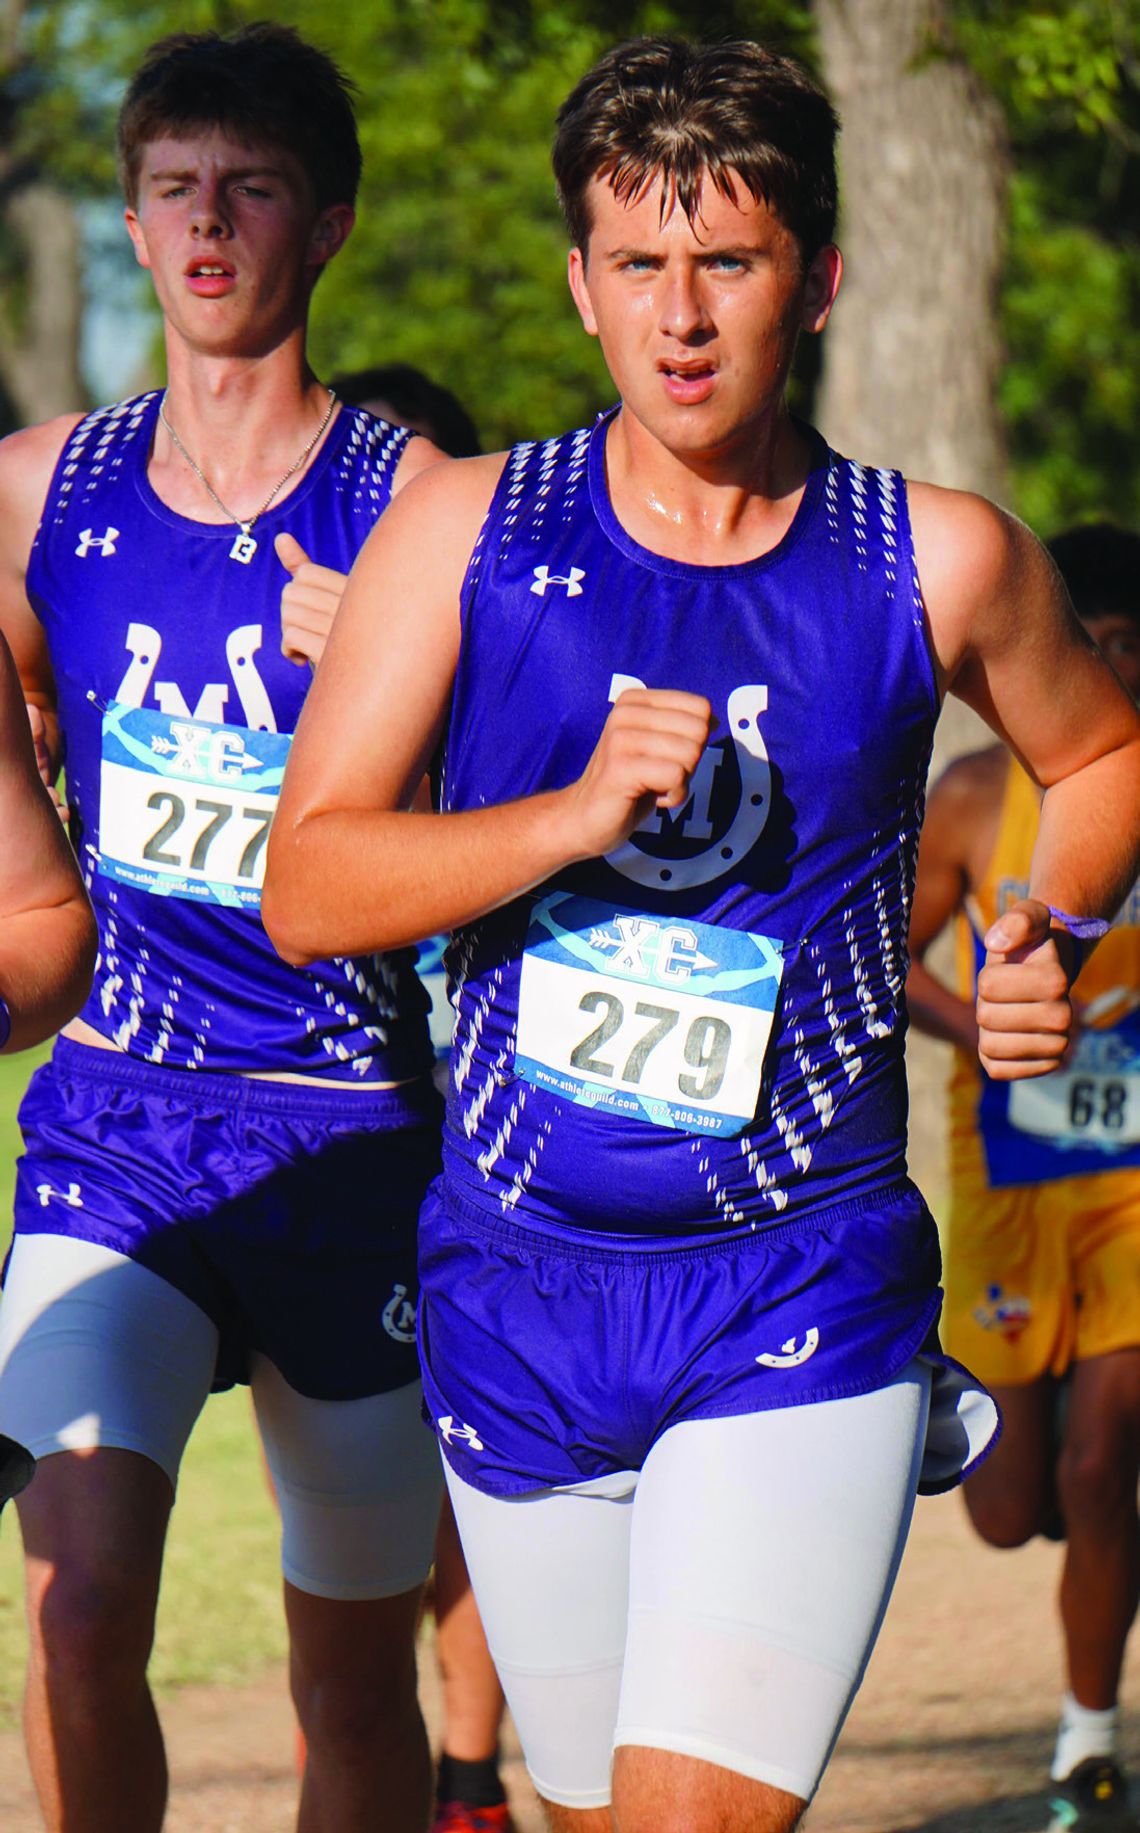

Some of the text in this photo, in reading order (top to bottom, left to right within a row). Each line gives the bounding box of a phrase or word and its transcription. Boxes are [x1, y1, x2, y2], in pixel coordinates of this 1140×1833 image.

[169, 722, 246, 785] XC
[142, 791, 275, 878] 277
[604, 913, 699, 985] XC
[570, 991, 732, 1100] 279
